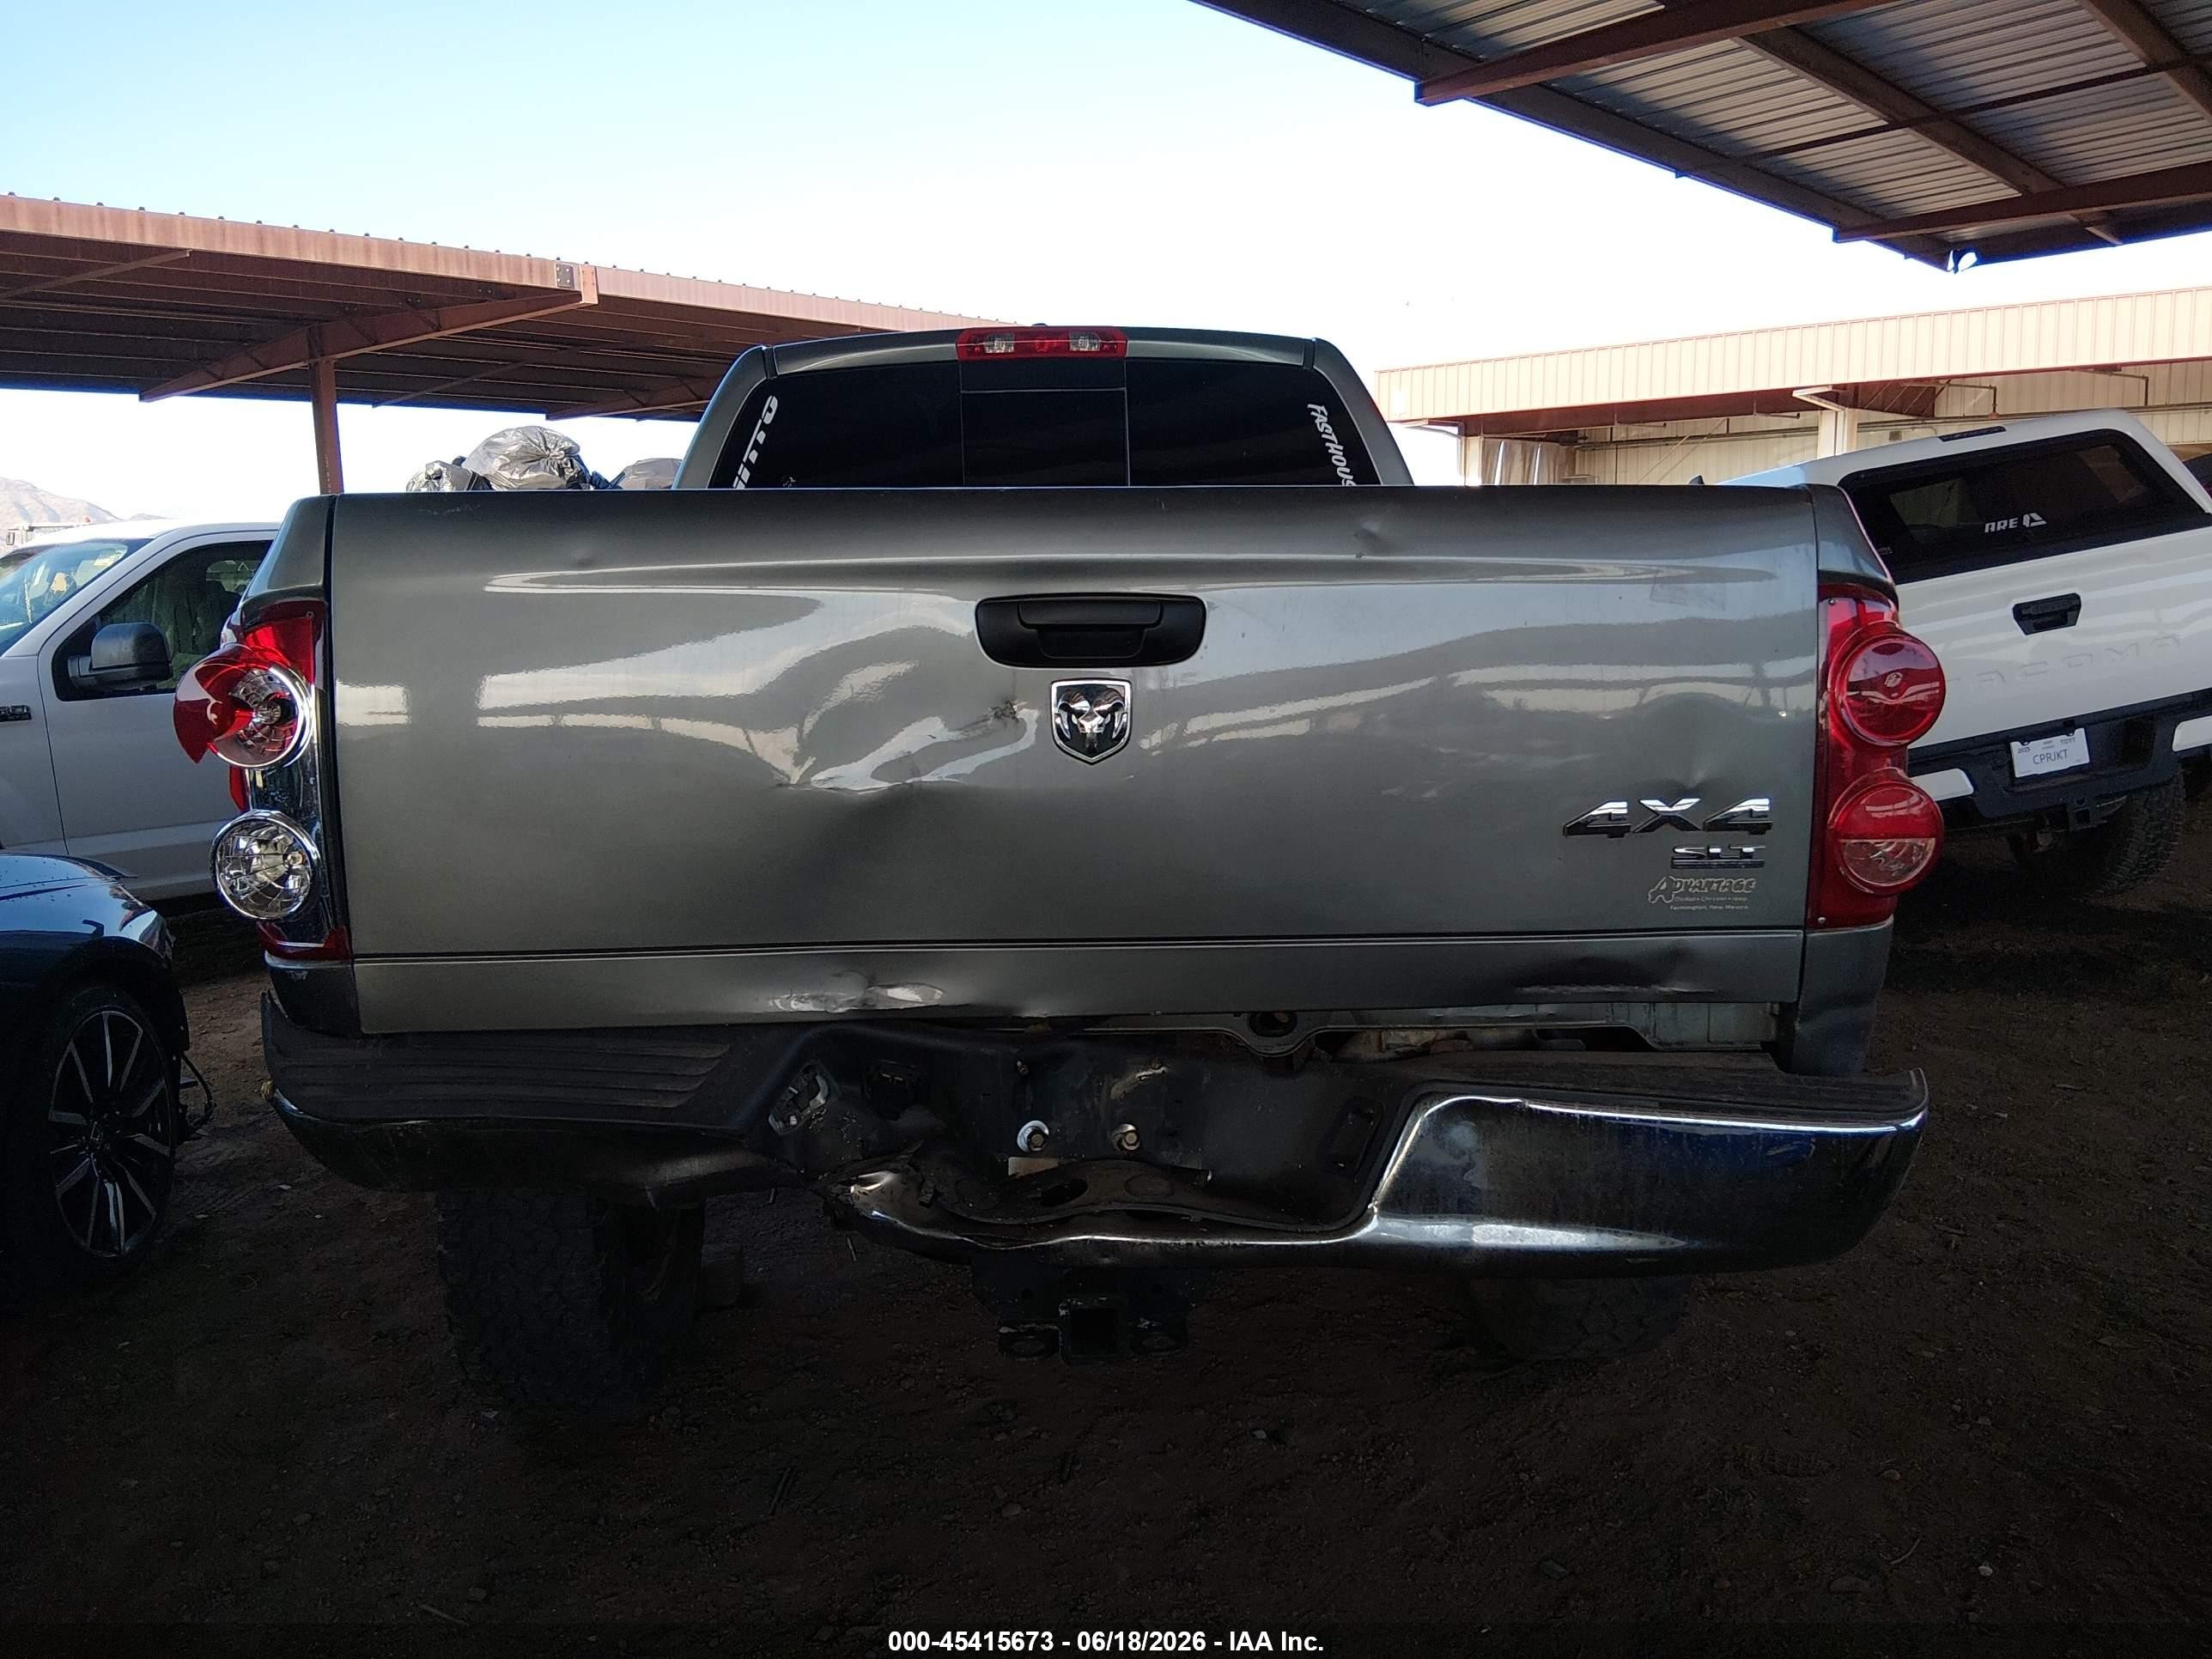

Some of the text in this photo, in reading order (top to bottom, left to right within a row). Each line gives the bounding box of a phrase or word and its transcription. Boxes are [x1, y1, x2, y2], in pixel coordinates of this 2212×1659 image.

[1984, 517, 2019, 533] ARE
[2033, 749, 2068, 765] CPRJKT
[1672, 844, 1766, 860] SLT
